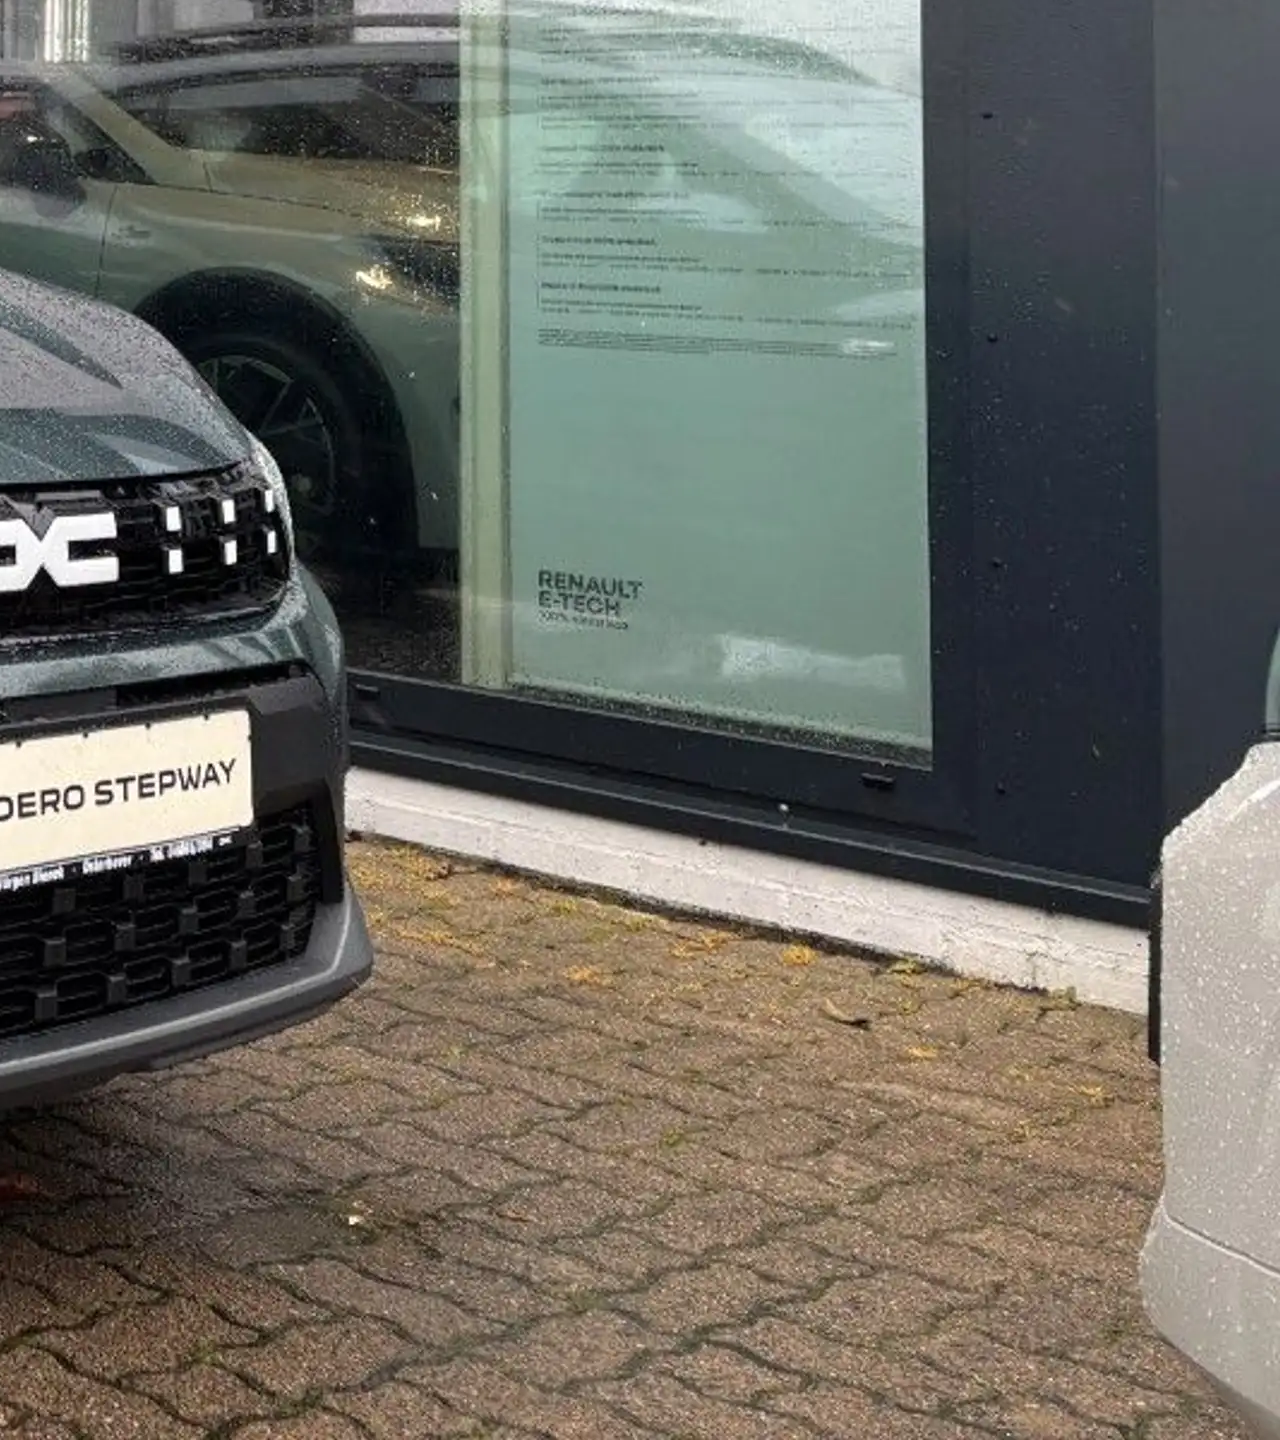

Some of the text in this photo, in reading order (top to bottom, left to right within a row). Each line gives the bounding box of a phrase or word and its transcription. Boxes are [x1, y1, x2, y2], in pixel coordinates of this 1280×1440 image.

[538, 569, 643, 600] RENAULT
[538, 589, 621, 617] E-TECH
[94, 758, 237, 806] STEPWAY
